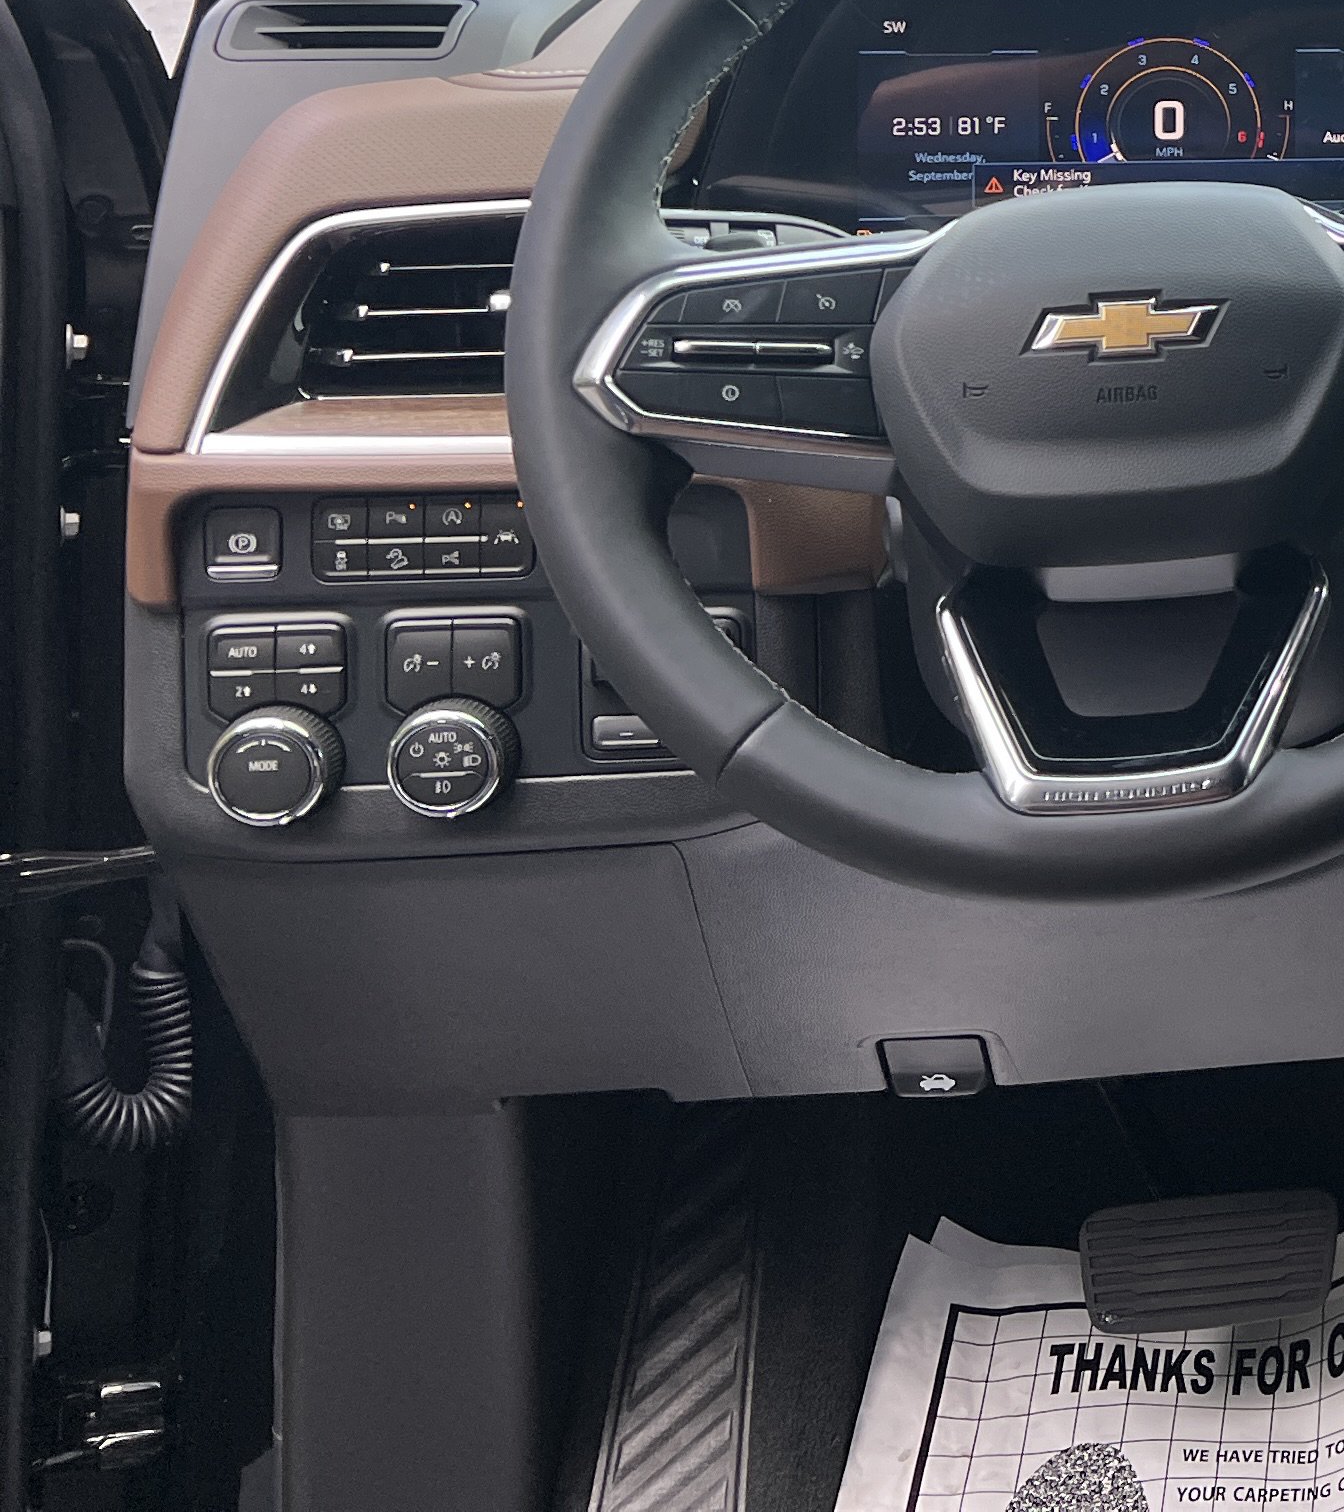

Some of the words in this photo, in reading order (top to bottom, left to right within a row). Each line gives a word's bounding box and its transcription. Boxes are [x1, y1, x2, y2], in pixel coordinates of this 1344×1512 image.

[883, 21, 907, 34] SW
[1137, 54, 1147, 66] 3
[1190, 54, 1200, 65] 4
[1100, 84, 1109, 96] 2
[1228, 83, 1238, 95] 5
[1044, 102, 1053, 114] F
[1284, 100, 1294, 110] H
[892, 117, 942, 136] 2:53
[1153, 100, 1185, 140] 0
[1237, 130, 1247, 143] 6
[914, 151, 987, 164] Wednesday,
[1155, 146, 1184, 158] MPH
[908, 170, 974, 184] September
[1013, 169, 1038, 184] Key
[1040, 169, 1092, 184] Missing
[1096, 384, 1158, 403] AIRBAG
[228, 646, 257, 658] AUTO
[428, 732, 457, 743] AUTO
[248, 759, 279, 772] MODE
[1048, 1343, 1216, 1396] THANKS
[1231, 1338, 1312, 1397] FOR
[1182, 1448, 1209, 1463] WE
[1216, 1449, 1264, 1464] HAVE
[1269, 1449, 1320, 1465] TRIED
[1176, 1486, 1226, 1503] YOUR
[1233, 1483, 1332, 1503] CARPETING
